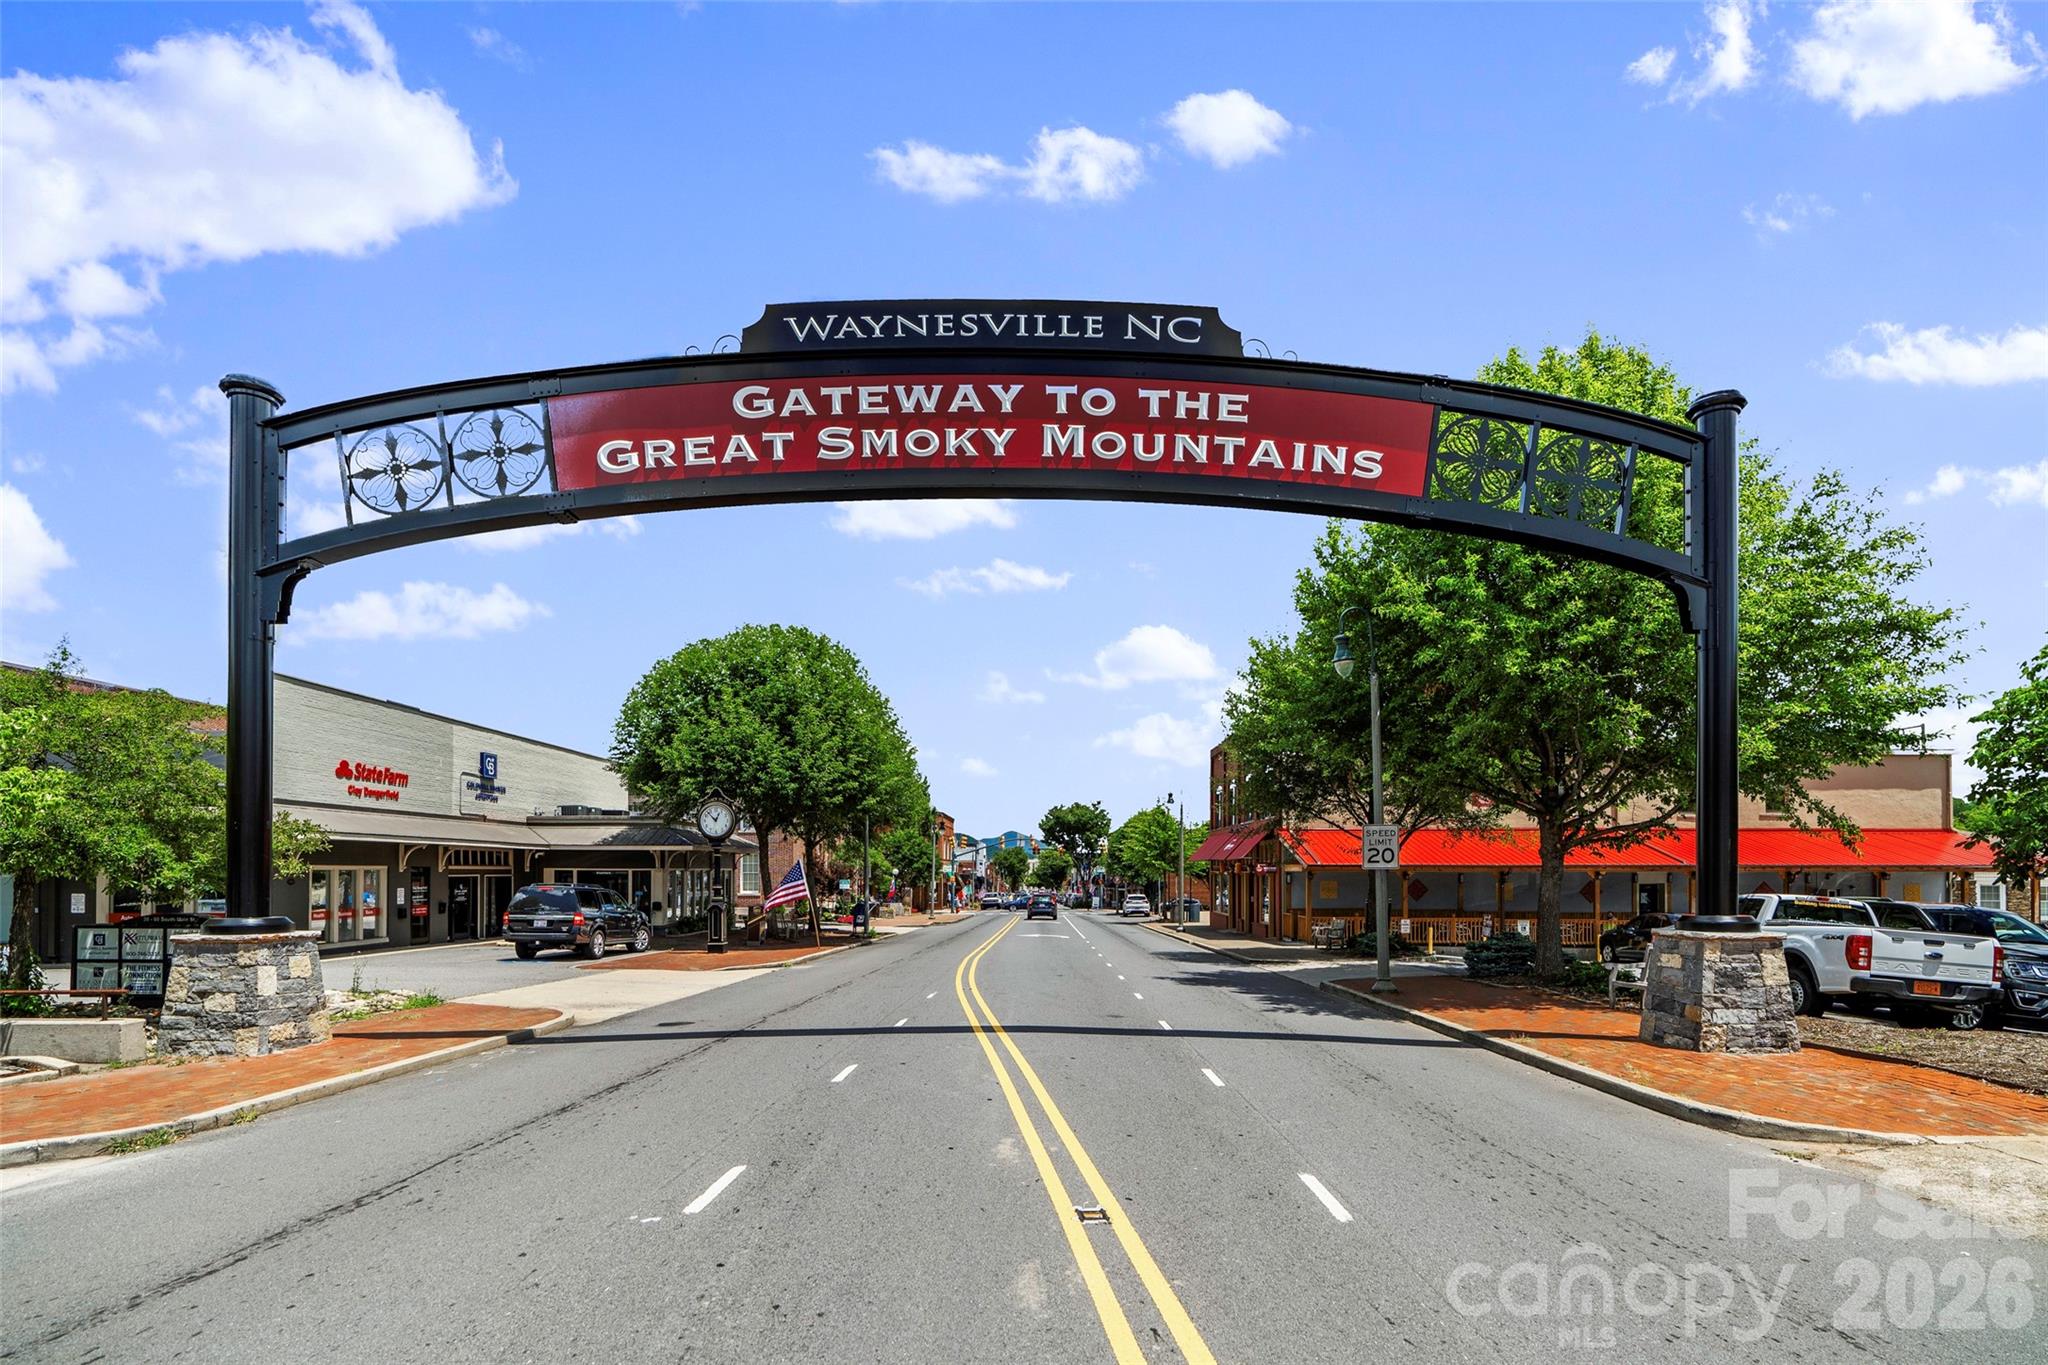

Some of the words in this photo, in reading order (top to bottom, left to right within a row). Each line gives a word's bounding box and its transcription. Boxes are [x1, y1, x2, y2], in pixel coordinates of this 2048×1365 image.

[783, 314, 1103, 343] WAYNESVILLE
[1123, 315, 1202, 344] NC
[732, 384, 1024, 419] GATEWAY
[1045, 384, 1117, 416] TO
[1138, 387, 1249, 423] THE
[596, 431, 795, 474] GREAT
[817, 426, 1017, 460] SMOKY
[1041, 423, 1384, 479] MOUNTAINS
[1367, 847, 1395, 864] 20
[1794, 900, 1818, 908] Building
